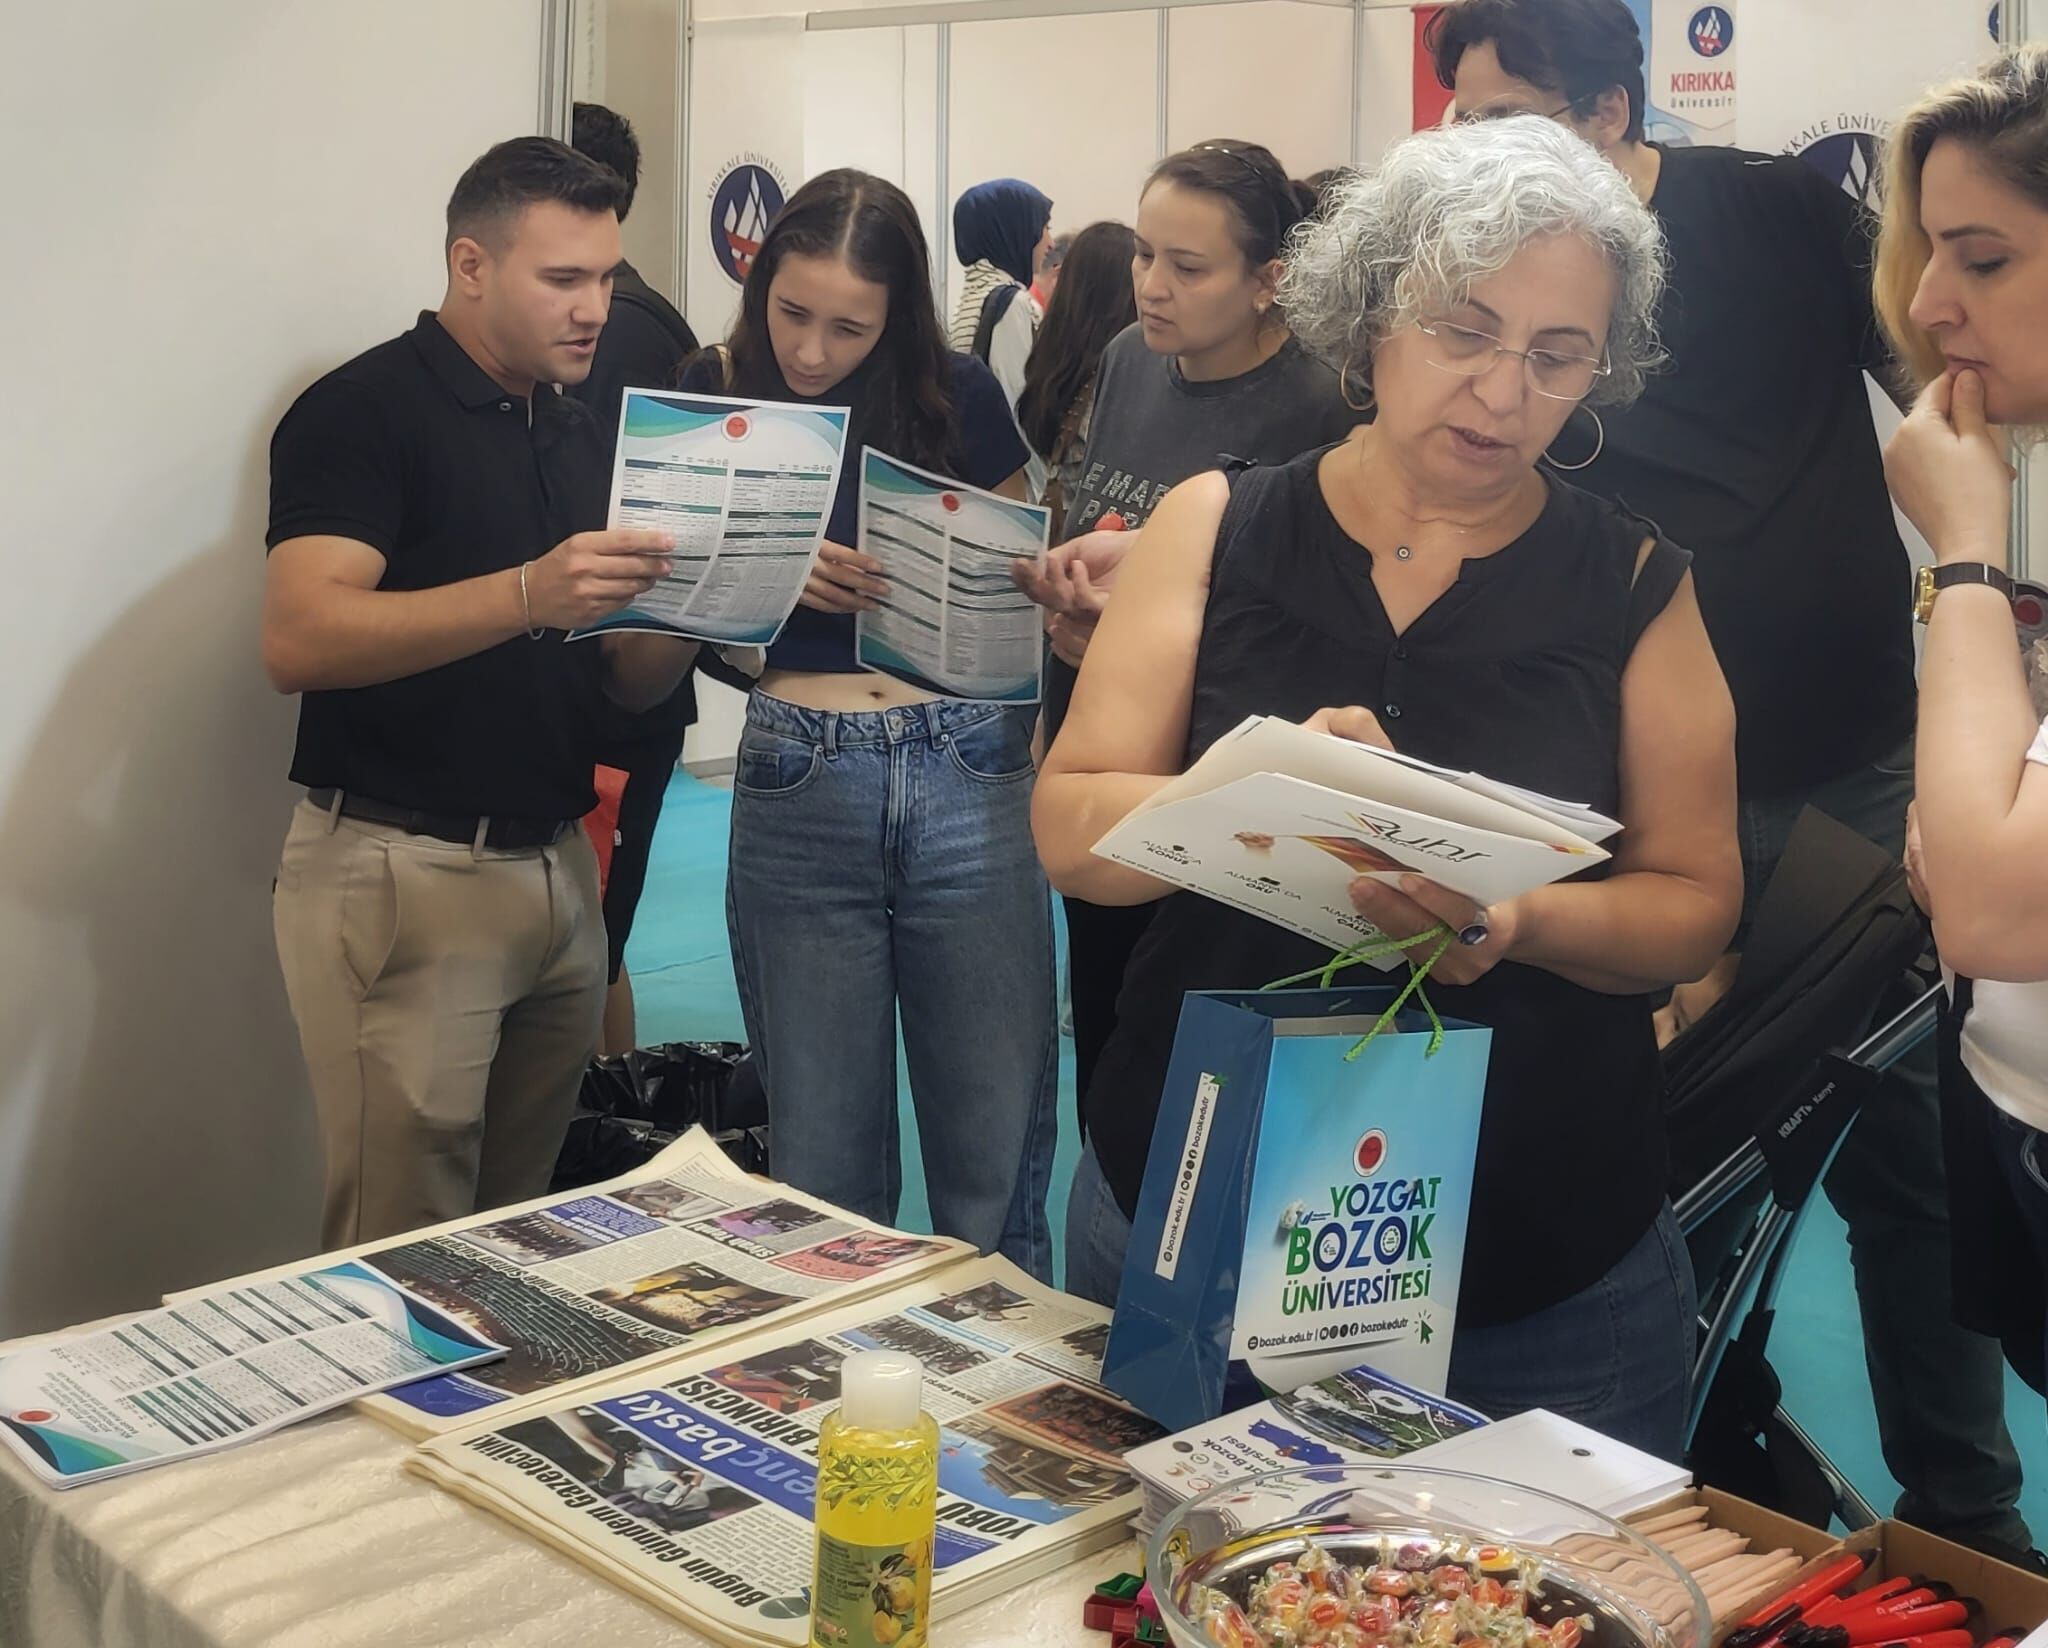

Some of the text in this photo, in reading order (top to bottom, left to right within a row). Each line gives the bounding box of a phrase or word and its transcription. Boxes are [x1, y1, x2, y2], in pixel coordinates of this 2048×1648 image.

[1671, 72, 1736, 93] KIRIKKA
[1671, 95, 1736, 108] ÜNİVERSİT
[1782, 112, 1890, 155] KKALE ÜNİVE
[707, 151, 790, 199] KIRIKKALE ÜNİVERSİTES
[1778, 1105, 1808, 1138] KRAFT
[1167, 1096, 1209, 1252] bozok.edu.tr bozokedutr
[1330, 1177, 1441, 1217] YOZGAT
[1286, 1213, 1436, 1276] BOZOK
[1282, 1263, 1431, 1316] ÜNİVERSİTESİ
[612, 1315, 649, 1334] Film
[1259, 1318, 1409, 1348] bozok.edu.tr bozokedutr
[661, 1374, 819, 1447] BİRİNCİSİ
[618, 1394, 817, 1502] ençbaskı
[1201, 1438, 1247, 1467] Bozok
[1220, 1435, 1286, 1471] versitesi
[461, 1434, 598, 1508] Gazetecilik!
[586, 1505, 691, 1562] Gündem
[679, 1558, 772, 1607] Bugün
